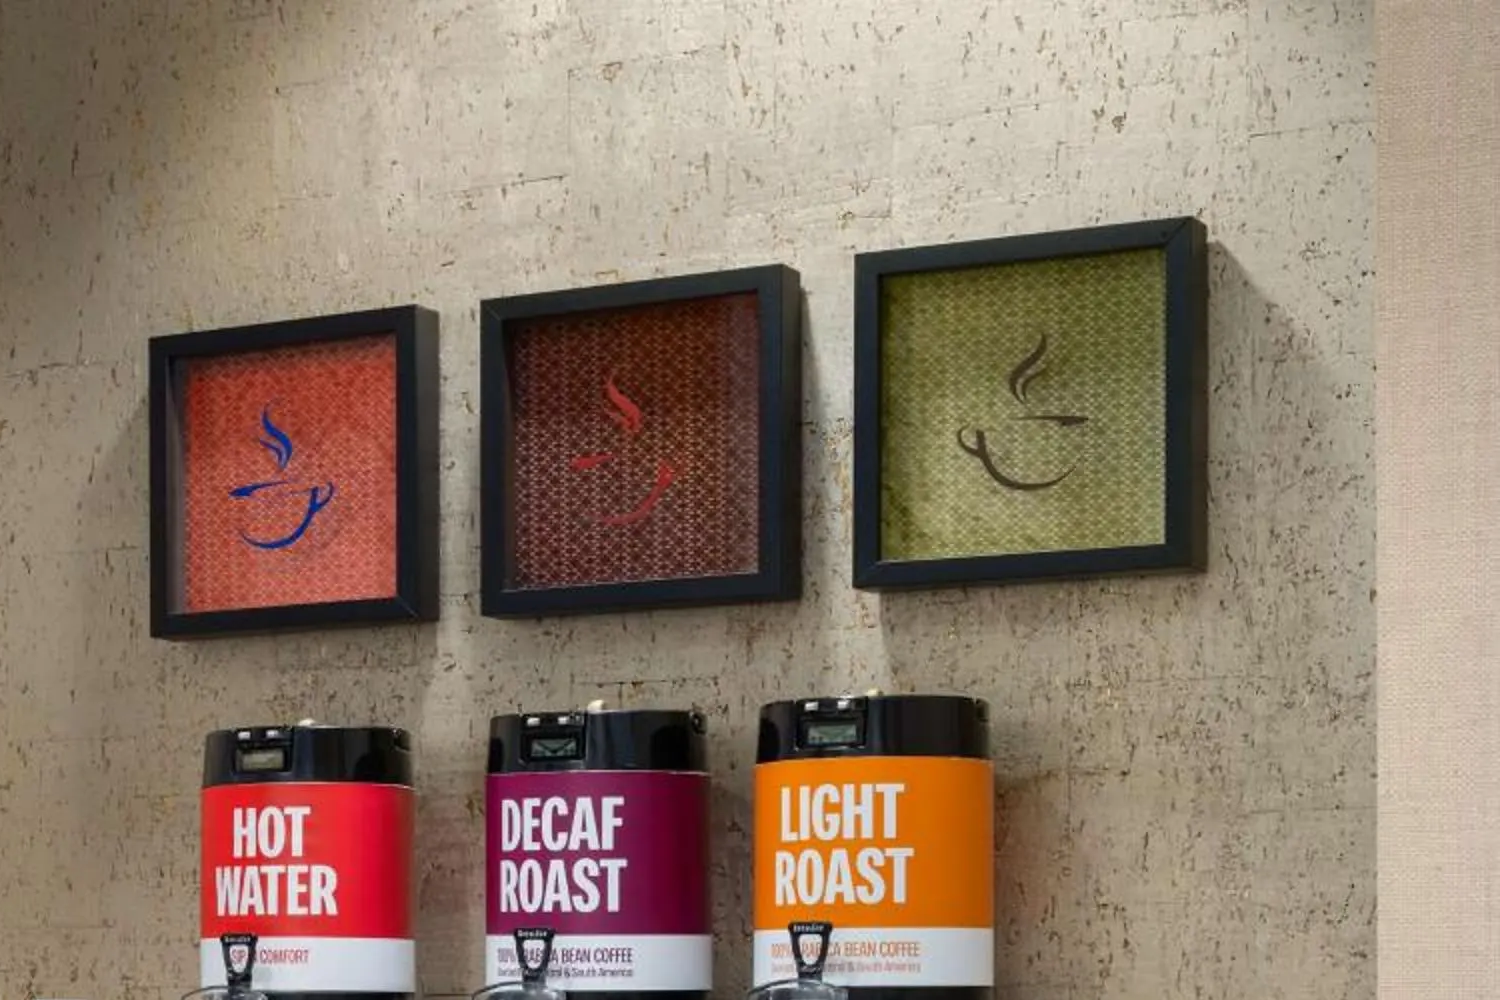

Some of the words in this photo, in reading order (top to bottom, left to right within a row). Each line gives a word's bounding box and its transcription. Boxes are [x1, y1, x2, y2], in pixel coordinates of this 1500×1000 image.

[233, 806, 311, 858] HOT
[501, 796, 625, 852] DECAF
[780, 783, 905, 842] LIGHT
[215, 865, 338, 917] WATER
[500, 858, 628, 913] ROAST
[775, 847, 915, 906] ROAST
[260, 949, 310, 964] COMFORT
[561, 948, 591, 963] BEAN
[593, 948, 633, 963] COFFEE
[844, 941, 877, 957] BEAN
[879, 941, 921, 957] COFFEE
